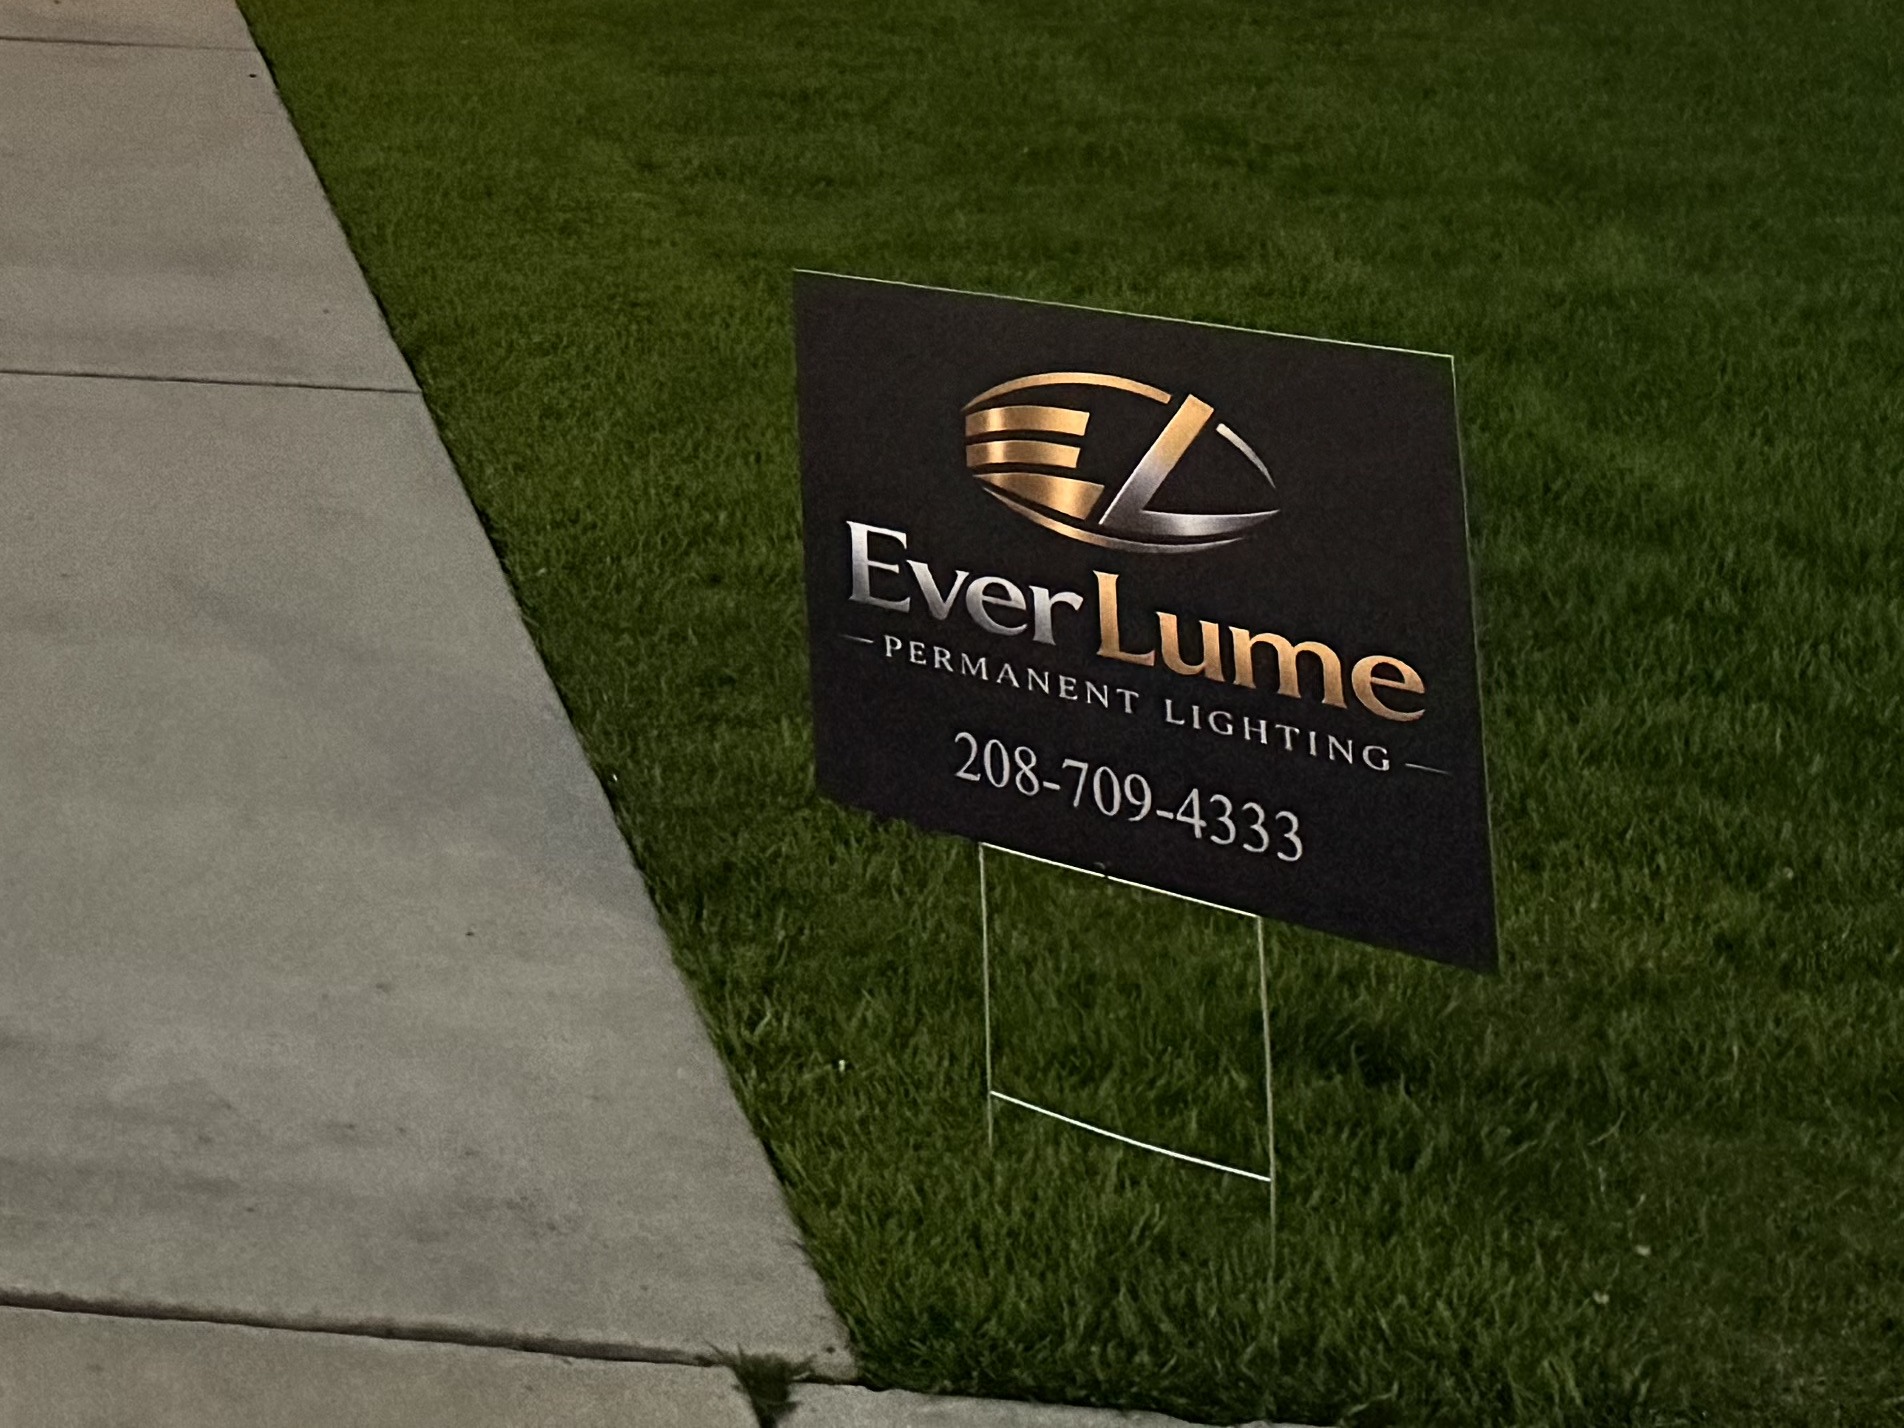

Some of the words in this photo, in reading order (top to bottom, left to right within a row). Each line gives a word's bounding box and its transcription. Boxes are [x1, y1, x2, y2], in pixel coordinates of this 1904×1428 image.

[845, 520, 1427, 722] EverLume
[883, 634, 1141, 715] PERMANENT
[1164, 698, 1393, 772] LIGHTING
[953, 731, 1304, 862] 208-709-4333
